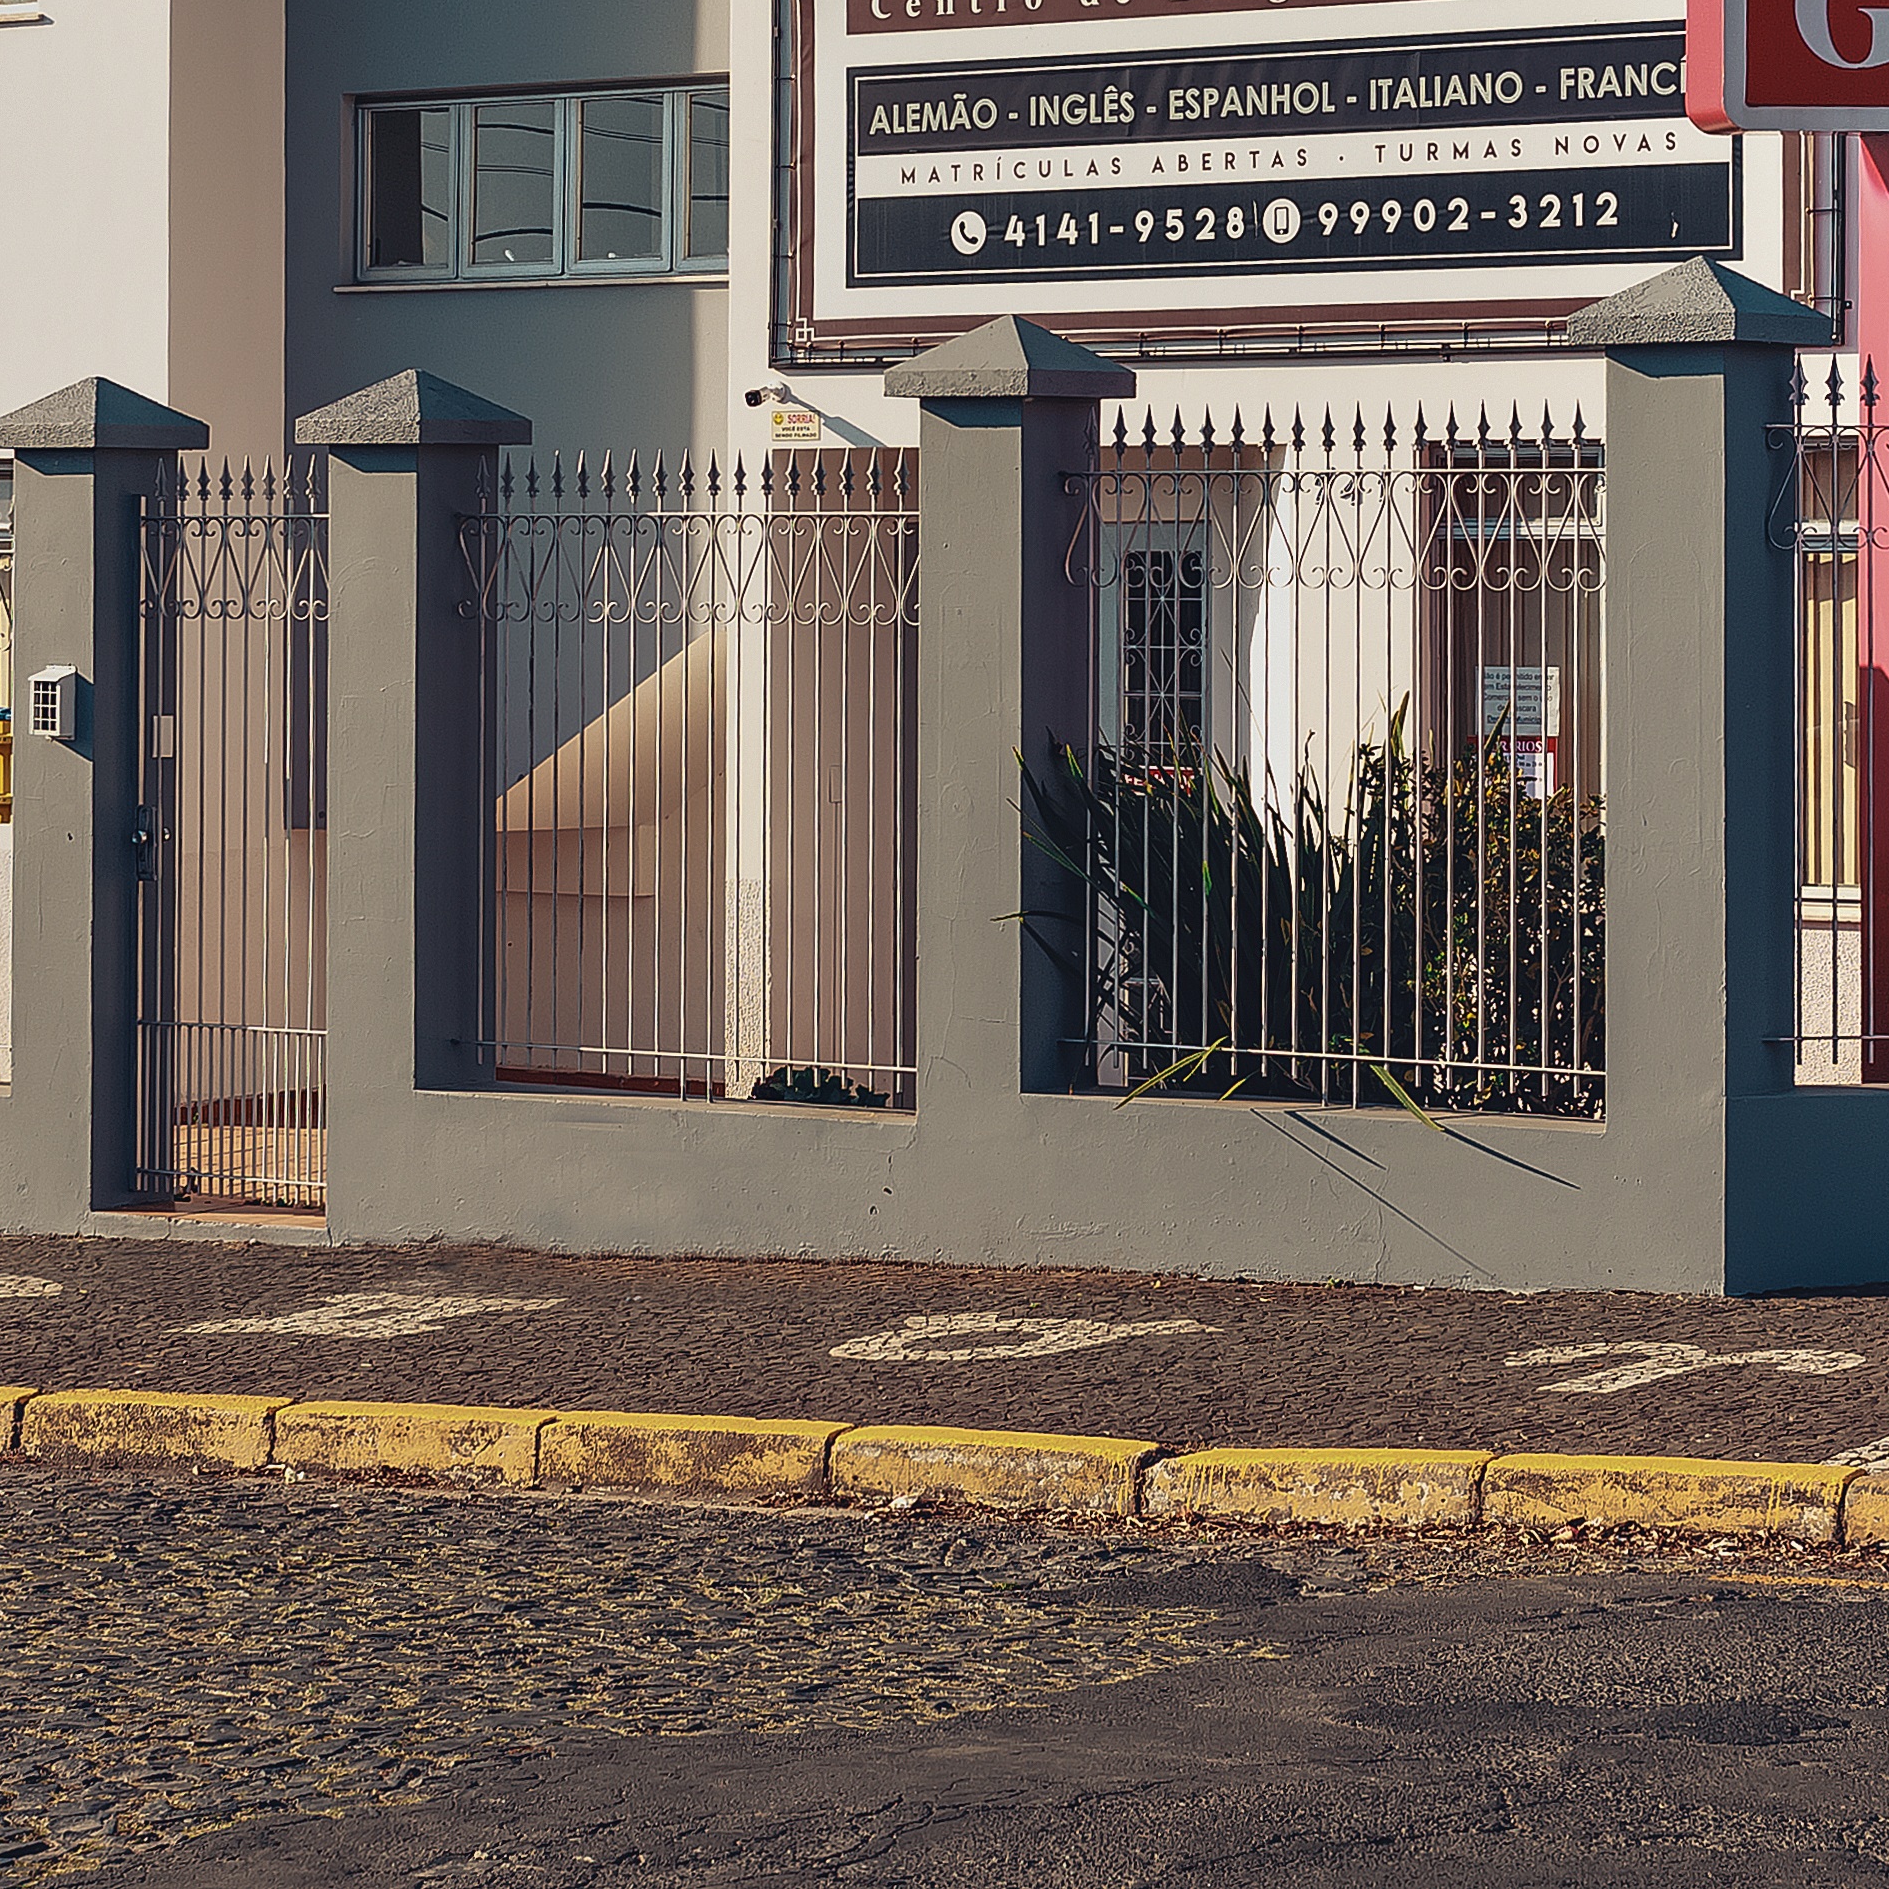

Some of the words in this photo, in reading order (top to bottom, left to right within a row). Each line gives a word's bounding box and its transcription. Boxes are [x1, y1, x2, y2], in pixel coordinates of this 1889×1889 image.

[869, 93, 998, 135] ALEMÃO
[1029, 85, 1135, 126] INGLÊS
[1169, 81, 1335, 122] ESPANHOL
[1370, 71, 1523, 111] ITALIANO
[1560, 54, 1687, 100] FRANC
[901, 157, 1122, 184] MATRÍCULAS
[1152, 148, 1307, 174] ABERTAS
[1375, 139, 1523, 163] TURMAS
[1555, 132, 1678, 156] NOVAS
[1004, 207, 1245, 247] 4141-9528
[1318, 191, 1619, 235] 99902-3212
